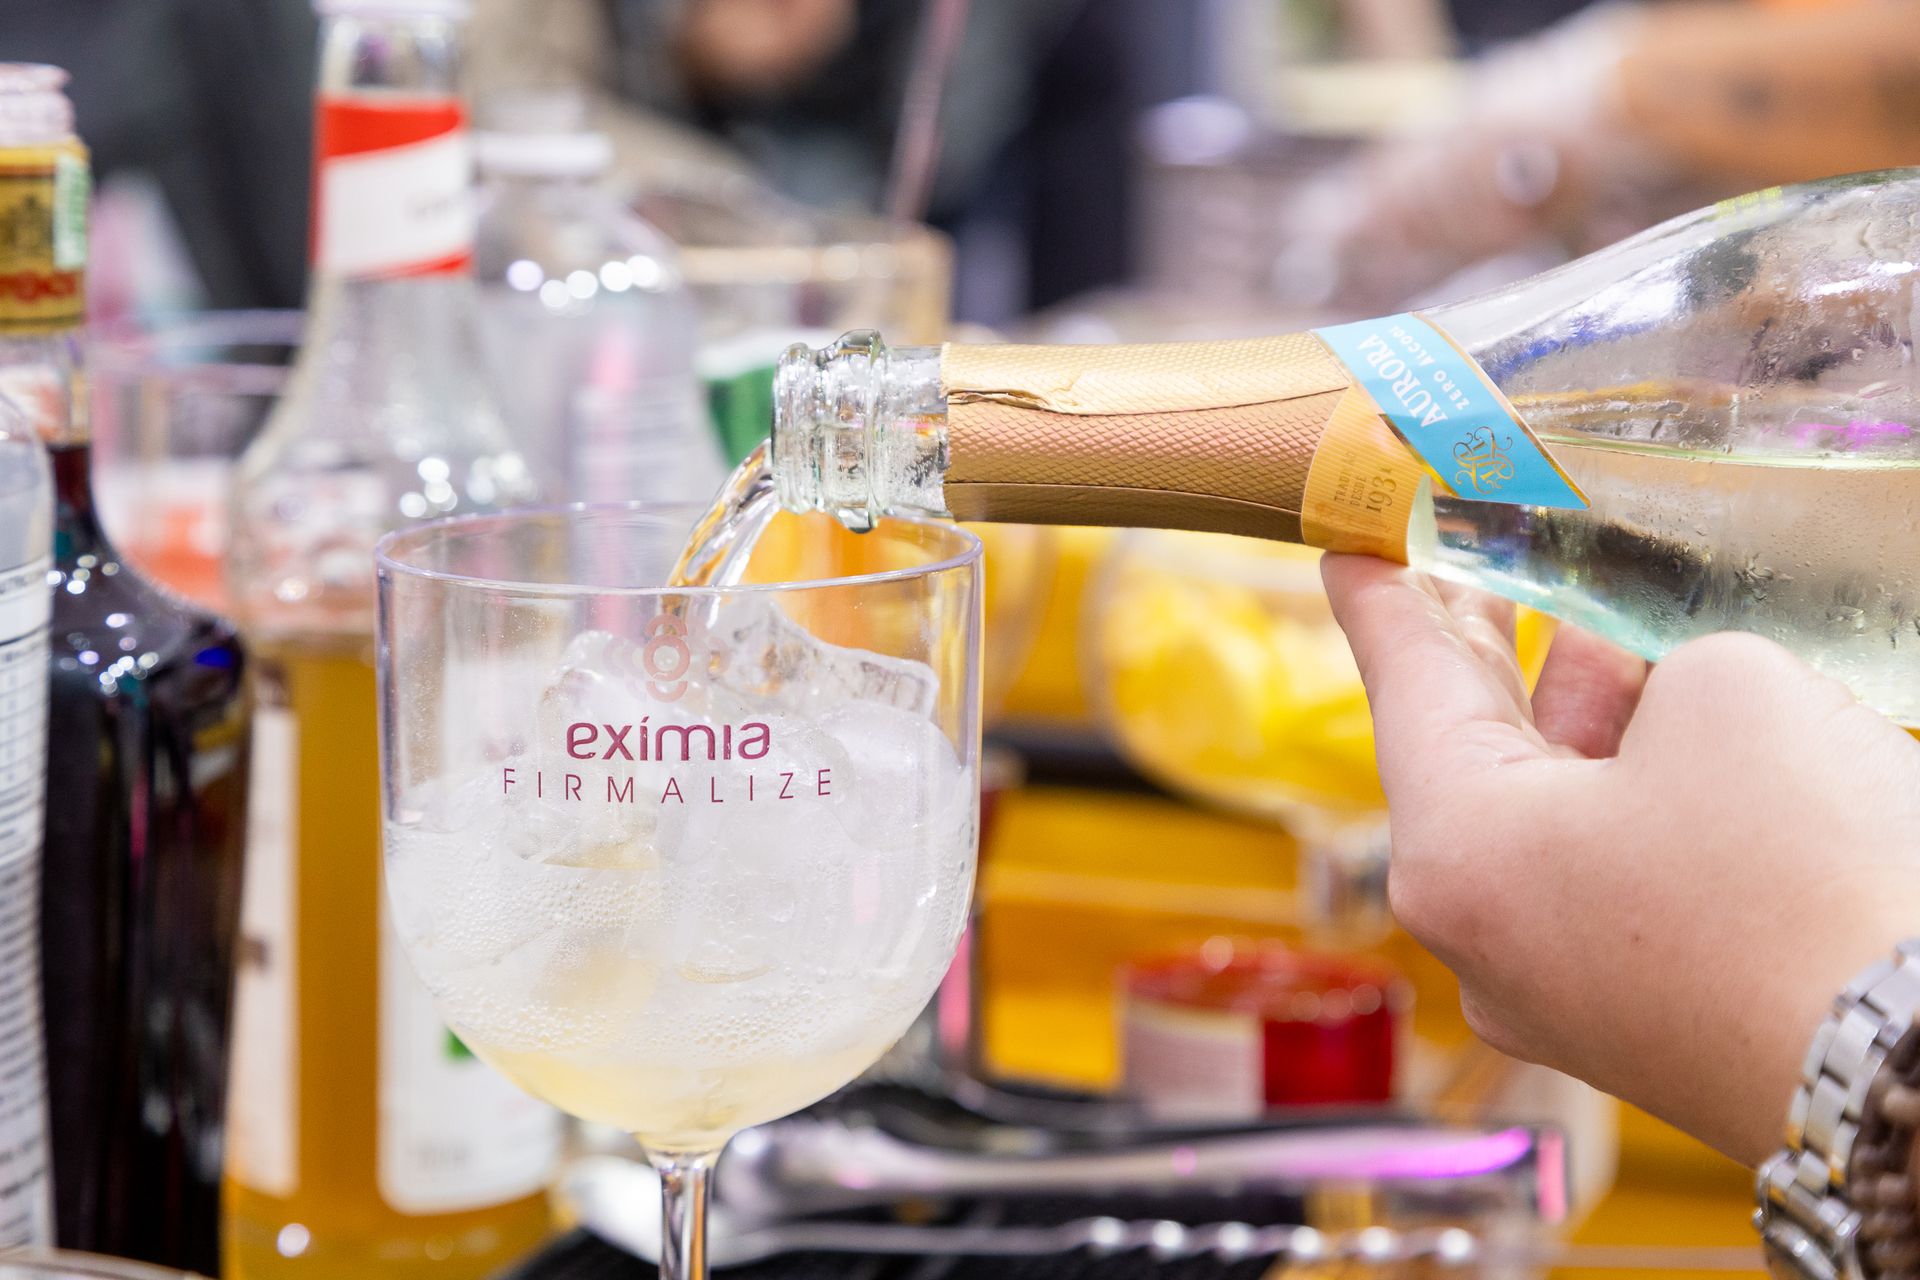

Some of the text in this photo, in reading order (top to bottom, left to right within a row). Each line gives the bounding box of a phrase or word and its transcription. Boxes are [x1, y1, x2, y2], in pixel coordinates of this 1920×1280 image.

[1356, 333, 1449, 428] AURORA
[1434, 368, 1471, 411] ZERO
[503, 767, 832, 804] FIRMALIZE
